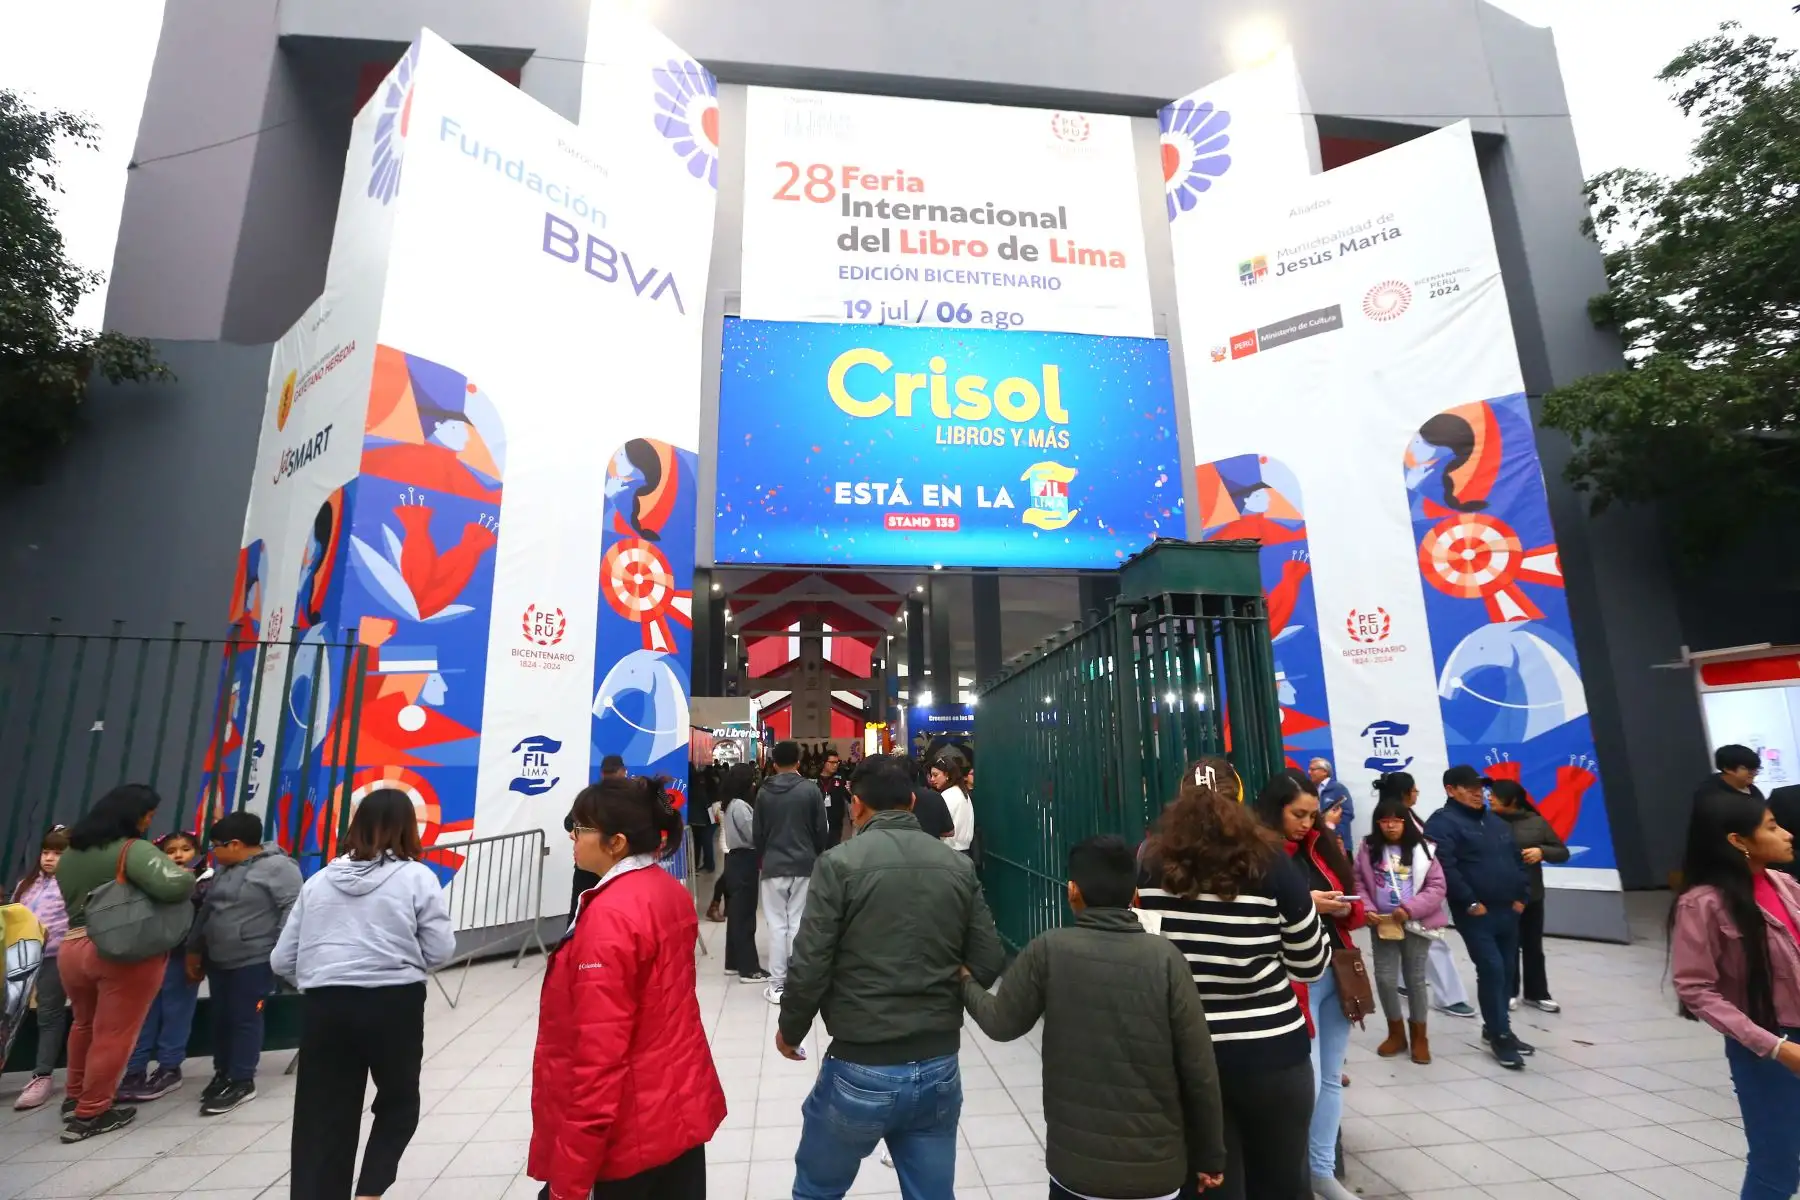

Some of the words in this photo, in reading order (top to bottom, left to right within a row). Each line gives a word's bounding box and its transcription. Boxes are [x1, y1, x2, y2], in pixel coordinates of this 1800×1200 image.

[440, 115, 608, 229] Fundación
[773, 160, 836, 203] 28
[841, 165, 925, 194] Feria
[840, 193, 1068, 230] Internacional
[1376, 211, 1395, 227] de
[836, 226, 890, 254] del
[900, 229, 989, 257] Libro
[997, 236, 1038, 262] de
[1049, 238, 1126, 269] Lima
[1275, 249, 1333, 277] Jesús
[1339, 225, 1402, 257] María
[542, 211, 686, 315] BBVA
[839, 263, 918, 283] EDICIÓN
[924, 268, 1062, 291] BICENTENARIO
[1429, 284, 1460, 299] 2024
[843, 299, 872, 319] 19
[878, 299, 909, 326] jul
[916, 299, 929, 324] /
[936, 301, 973, 324] 06
[980, 309, 1025, 331] ago
[1261, 325, 1297, 342] Ministerio
[1298, 321, 1308, 331] de
[1308, 314, 1337, 327] Cultura
[827, 347, 1070, 425] Crisol
[936, 425, 1005, 447] LIBROS
[1010, 428, 1024, 448] Y
[1028, 423, 1070, 449] MÁS
[834, 477, 912, 506] ESTÁ
[922, 484, 962, 508] EN
[977, 485, 1015, 509] LA
[888, 514, 931, 529] STAND
[935, 516, 956, 529] 135
[535, 611, 554, 625] PE
[511, 648, 575, 662] BICENTENARIO
[1342, 644, 1407, 657] BICENTENARIO
[1372, 736, 1399, 748] FIL
[1374, 749, 1401, 757] LIMA
[521, 767, 549, 777] LIMA
[523, 753, 549, 767] FIL
